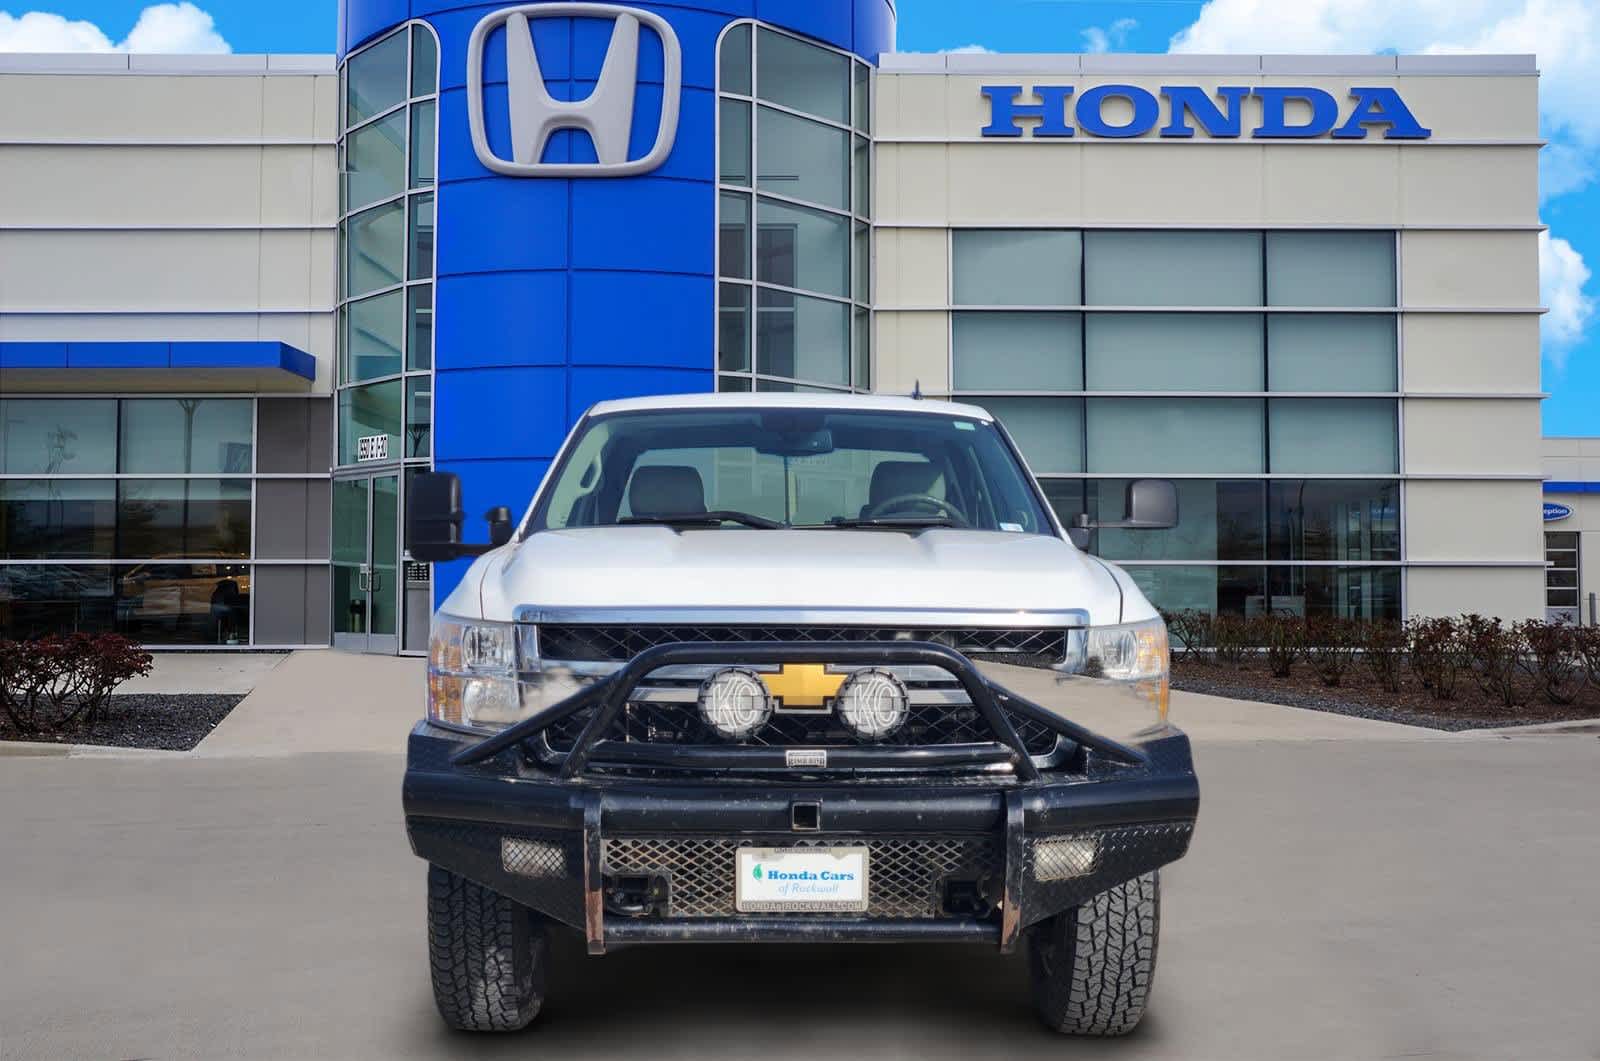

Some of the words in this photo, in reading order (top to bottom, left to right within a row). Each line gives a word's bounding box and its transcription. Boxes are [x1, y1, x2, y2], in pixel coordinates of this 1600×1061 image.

[981, 85, 1431, 139] HONDA
[711, 677, 759, 729] KC
[853, 678, 898, 730] KC
[767, 870, 818, 881] Honda
[820, 870, 855, 881] Cars
[778, 883, 788, 896] of
[791, 882, 840, 894] Rockwall
